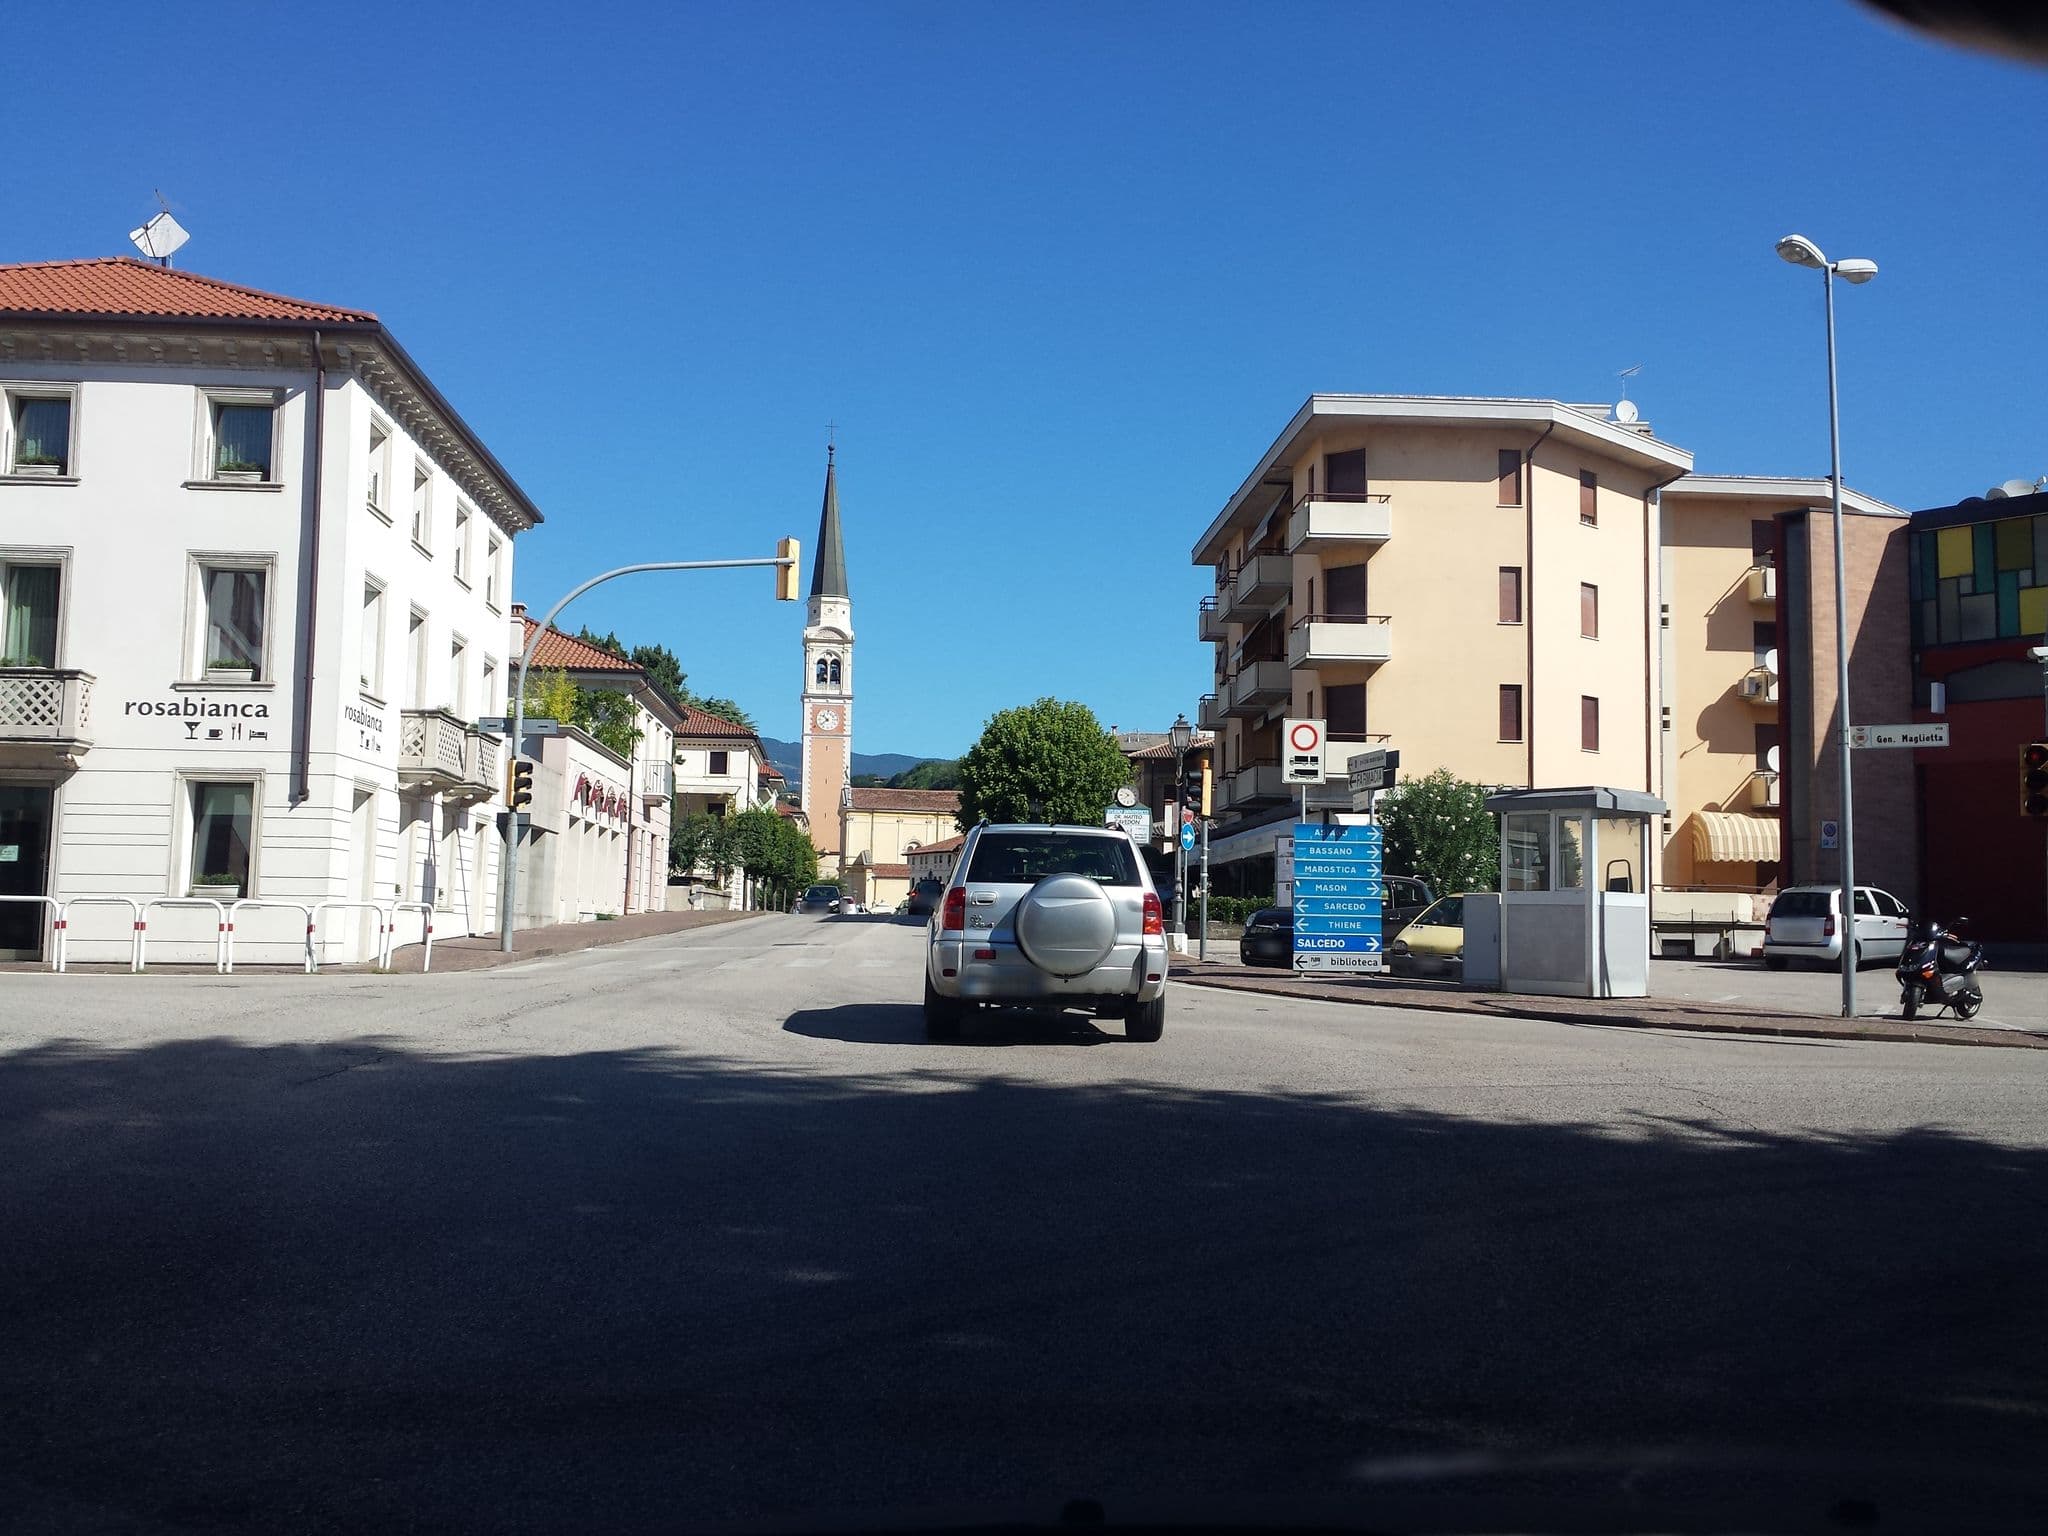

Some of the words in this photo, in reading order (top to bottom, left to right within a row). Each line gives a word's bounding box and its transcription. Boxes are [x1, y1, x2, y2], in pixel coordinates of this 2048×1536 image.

[124, 697, 270, 718] rosabianca
[344, 705, 383, 732] rosabianca
[1876, 735, 1896, 744] Gen.
[1901, 734, 1943, 744] Maglietta
[1314, 828, 1348, 838] ASAO
[1309, 847, 1353, 856] BASSANO
[1304, 865, 1357, 874] MAROSTICA
[1315, 884, 1347, 892] MASON
[1324, 902, 1366, 911] SARCEDO
[1328, 921, 1362, 929] THIENE
[1296, 938, 1346, 948] SALCEDO
[1330, 957, 1378, 967] biblioteca
